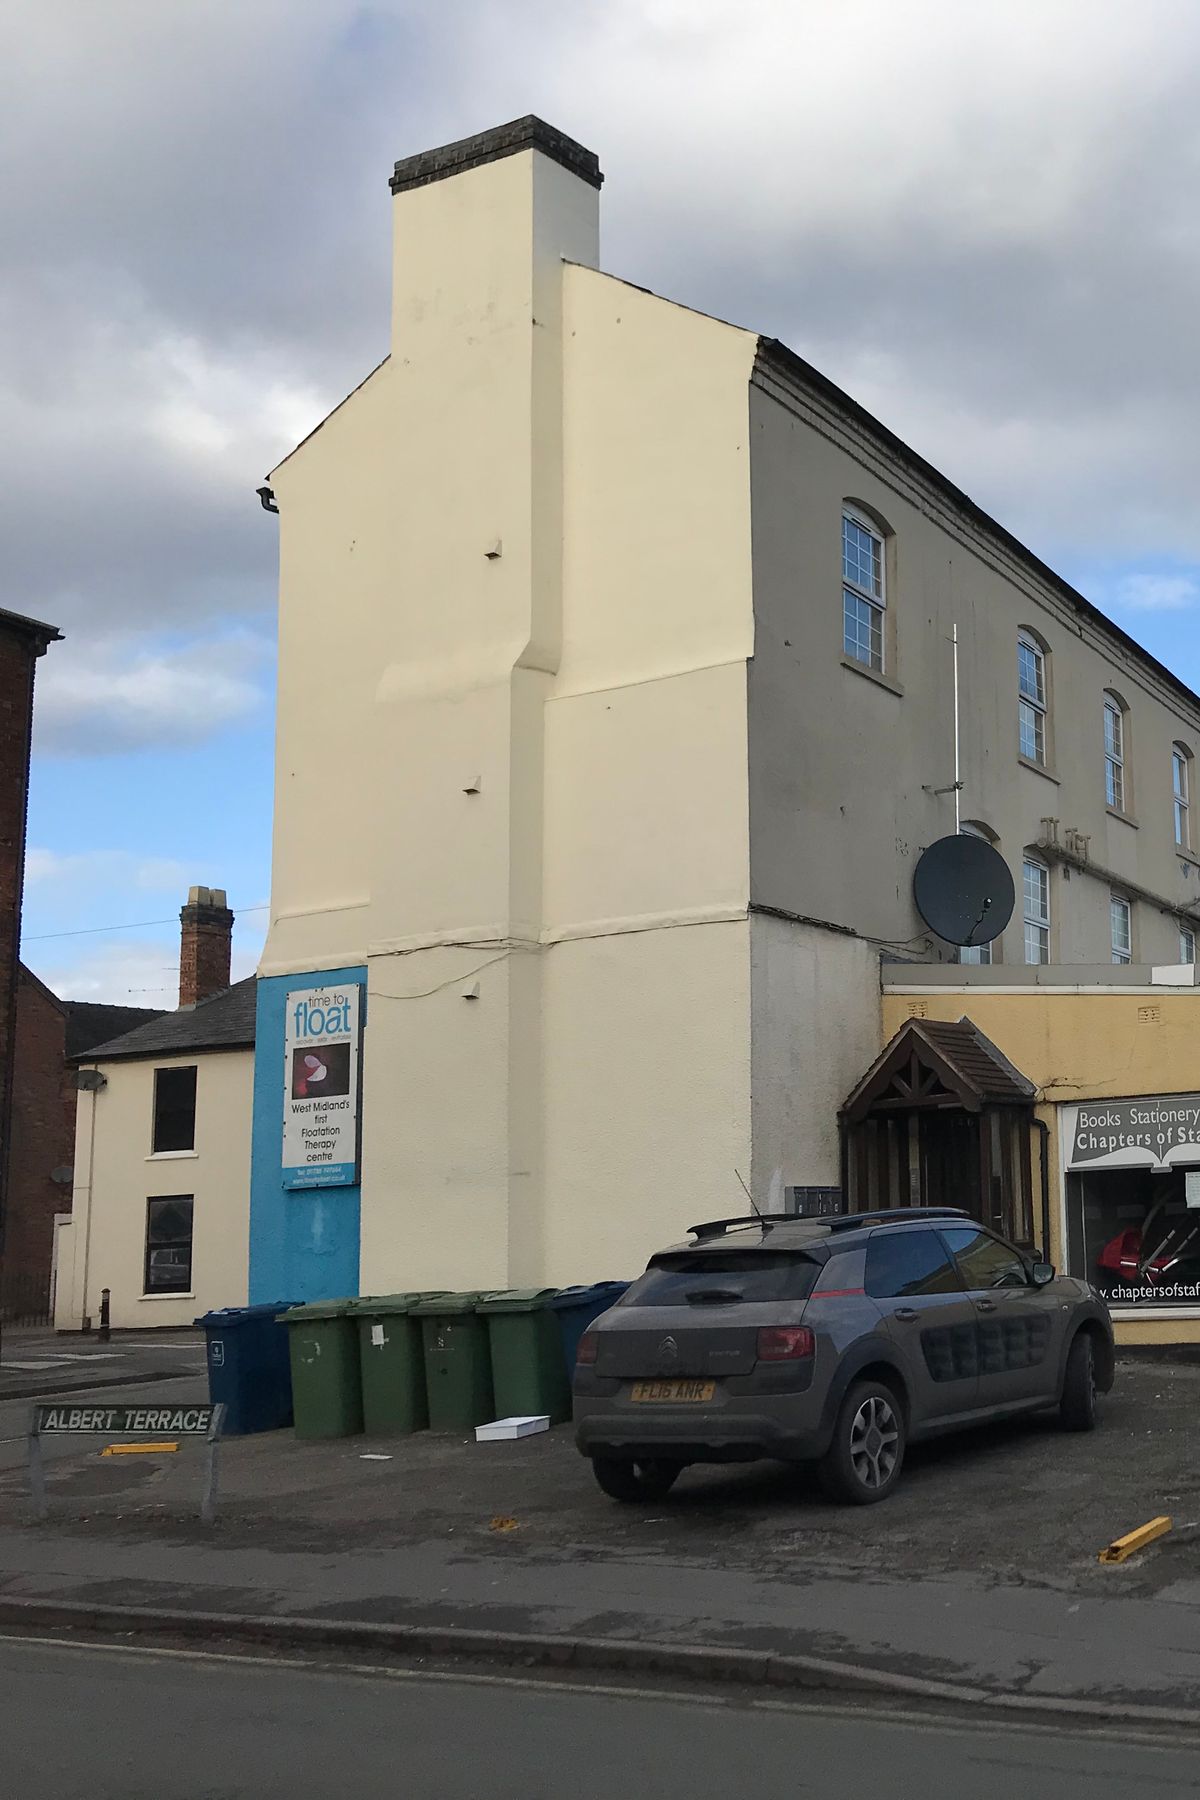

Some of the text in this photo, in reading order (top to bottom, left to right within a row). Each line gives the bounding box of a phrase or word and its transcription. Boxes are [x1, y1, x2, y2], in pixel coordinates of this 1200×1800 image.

[308, 993, 344, 1008] time to
[294, 997, 352, 1038] float
[291, 1100, 350, 1114] West Midland's
[314, 1114, 328, 1124] first
[1079, 1110, 1121, 1128] Books
[1129, 1107, 1200, 1126] Stationery
[301, 1126, 341, 1138] Floatation
[305, 1139, 337, 1150] Therapy
[1076, 1132, 1151, 1152] Chapters
[1156, 1127, 1173, 1144] of
[306, 1153, 333, 1162] centre
[44, 1408, 211, 1431] ALBERT TERRACE
